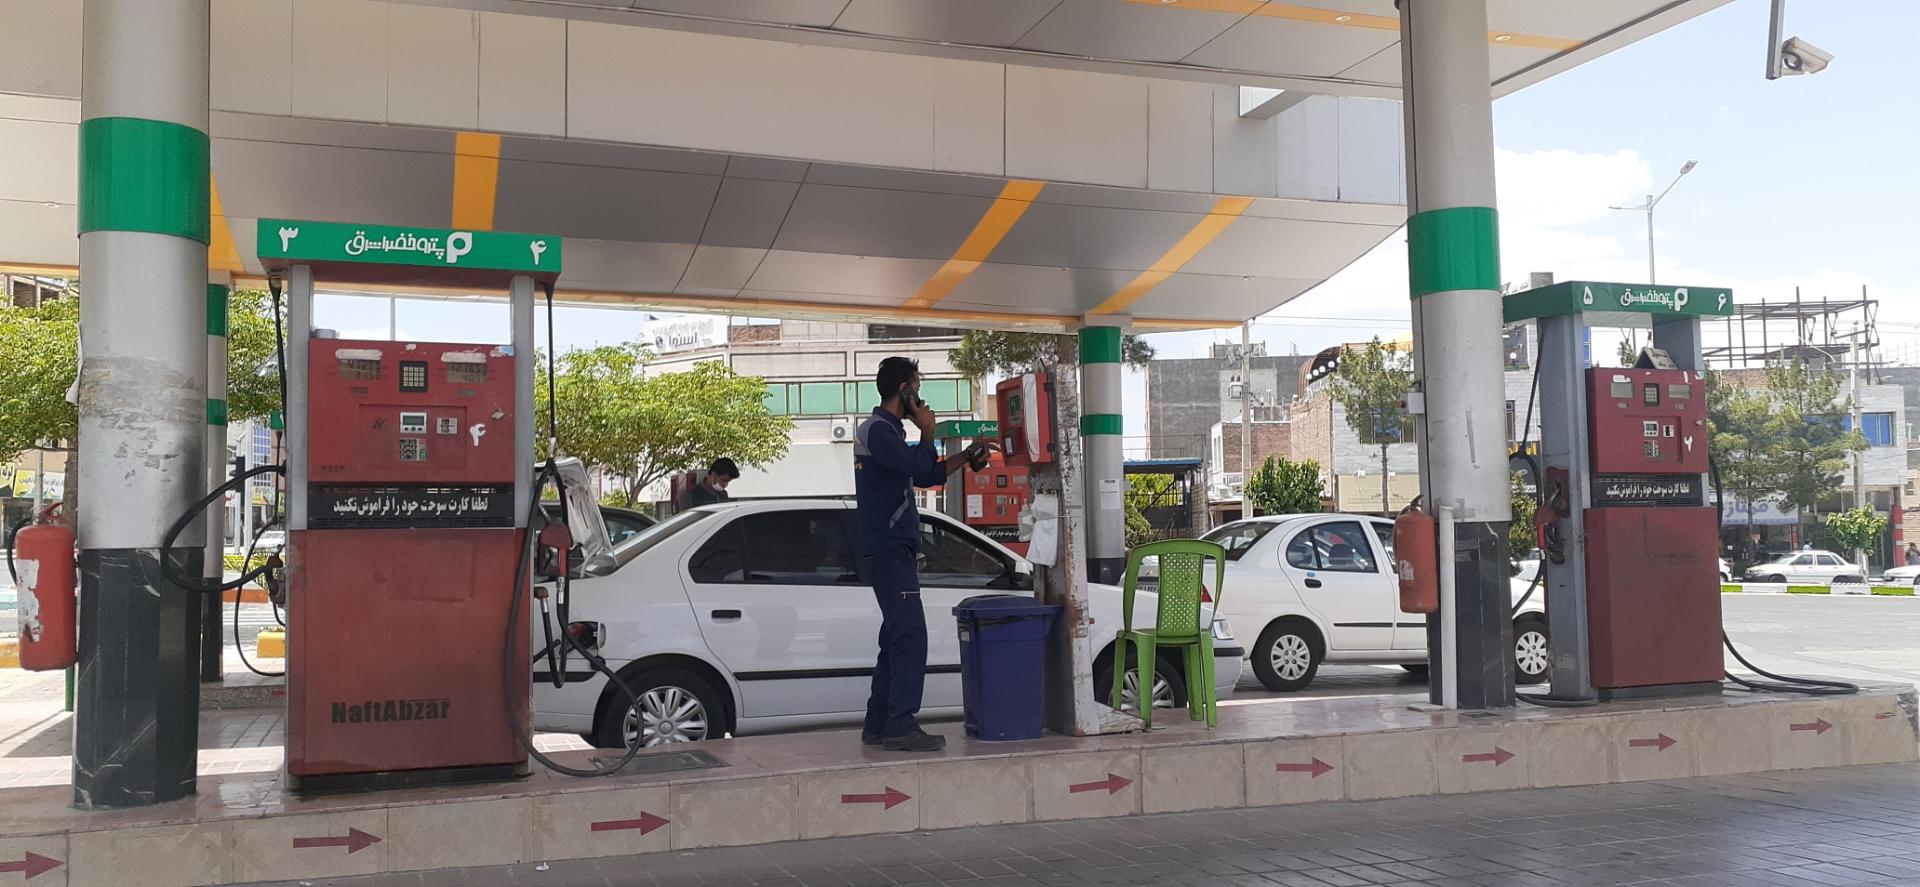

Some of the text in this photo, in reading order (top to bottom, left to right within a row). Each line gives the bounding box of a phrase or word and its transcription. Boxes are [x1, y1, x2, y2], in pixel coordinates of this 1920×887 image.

[279, 226, 298, 252] ۳
[530, 240, 547, 265] ۴
[1583, 286, 1593, 305] ۵
[1718, 293, 1727, 311] ۶
[470, 423, 486, 446] ۴
[333, 495, 488, 515] لطفا کارت سوخت خود را فراموش نکنید
[331, 699, 450, 723] NaftAbzar
